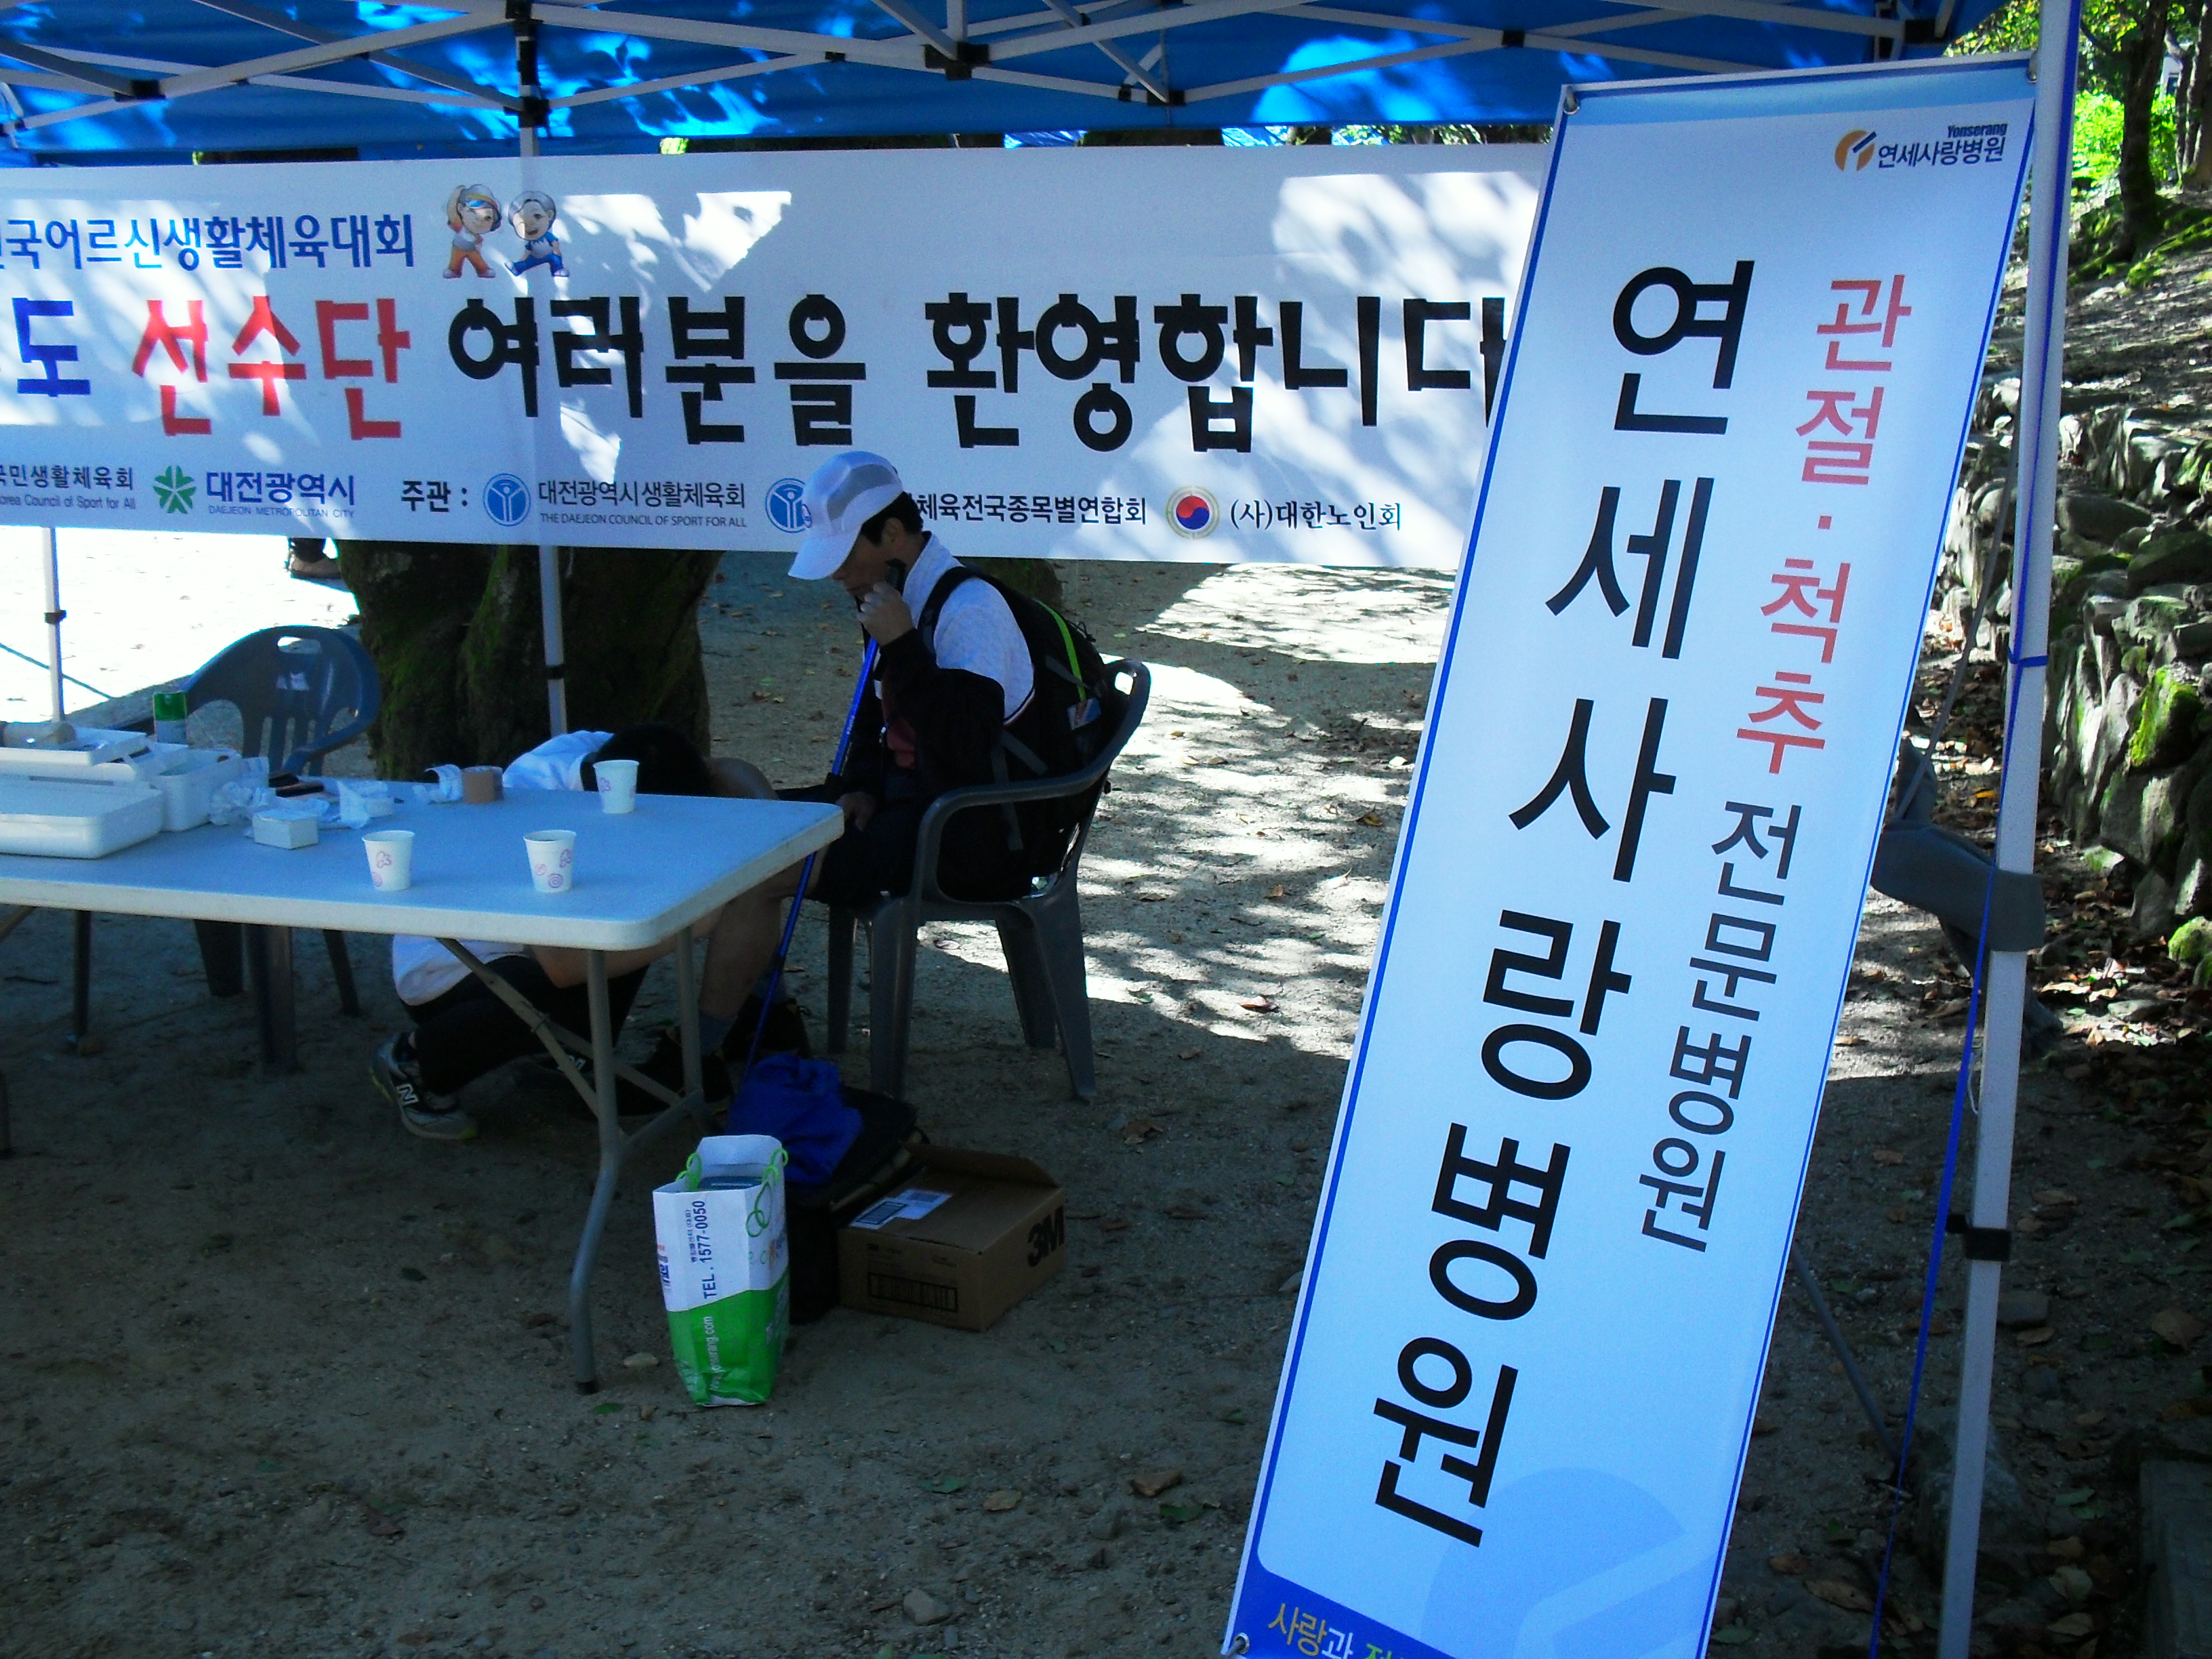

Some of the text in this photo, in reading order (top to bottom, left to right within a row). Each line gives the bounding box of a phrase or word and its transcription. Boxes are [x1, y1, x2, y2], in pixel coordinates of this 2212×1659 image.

[1878, 136, 2005, 169] 연세사랑병원
[0, 213, 414, 270] 국어르신생활체육대회
[12, 292, 1507, 453] 도 선수단 여러분을 환영합니다
[206, 472, 354, 506] 대전광역시
[401, 480, 451, 512] 주관
[907, 493, 1147, 525] 체육전국종목별연합회
[209, 506, 355, 518] DAEJEON METROPOLITAN CITY
[541, 513, 747, 528] THE DAEJEON COUNCIL OF SPORT FOR ALL
[1230, 499, 1401, 531] (사)대한노인회
[1374, 260, 1755, 1547] 연세사랑병원
[1639, 800, 1802, 1253] 전문병원
[692, 1200, 713, 1263] 1577-0050
[1027, 1205, 1065, 1268] 3M
[1268, 1603, 1354, 1659] 사랑과
